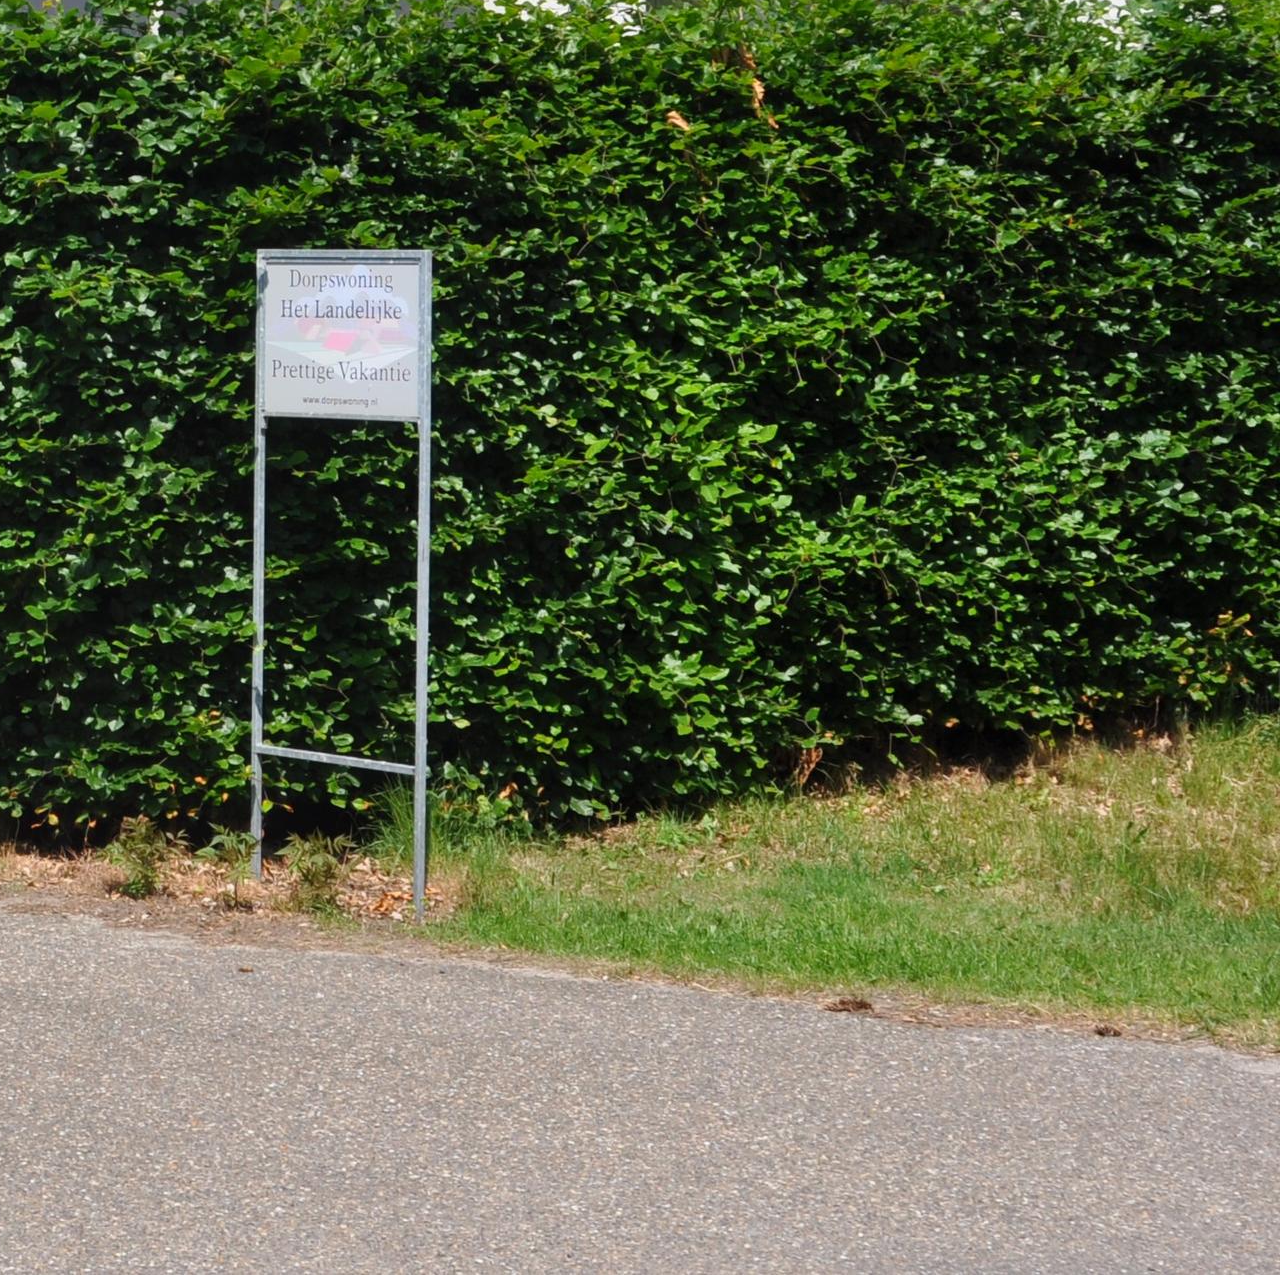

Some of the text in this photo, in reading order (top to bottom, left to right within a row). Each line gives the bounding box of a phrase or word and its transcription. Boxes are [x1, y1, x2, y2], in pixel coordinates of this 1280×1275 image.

[289, 268, 394, 293] Dorpswoning
[280, 299, 403, 324] Het Landelijke
[271, 359, 411, 384] Prettige Vakantie
